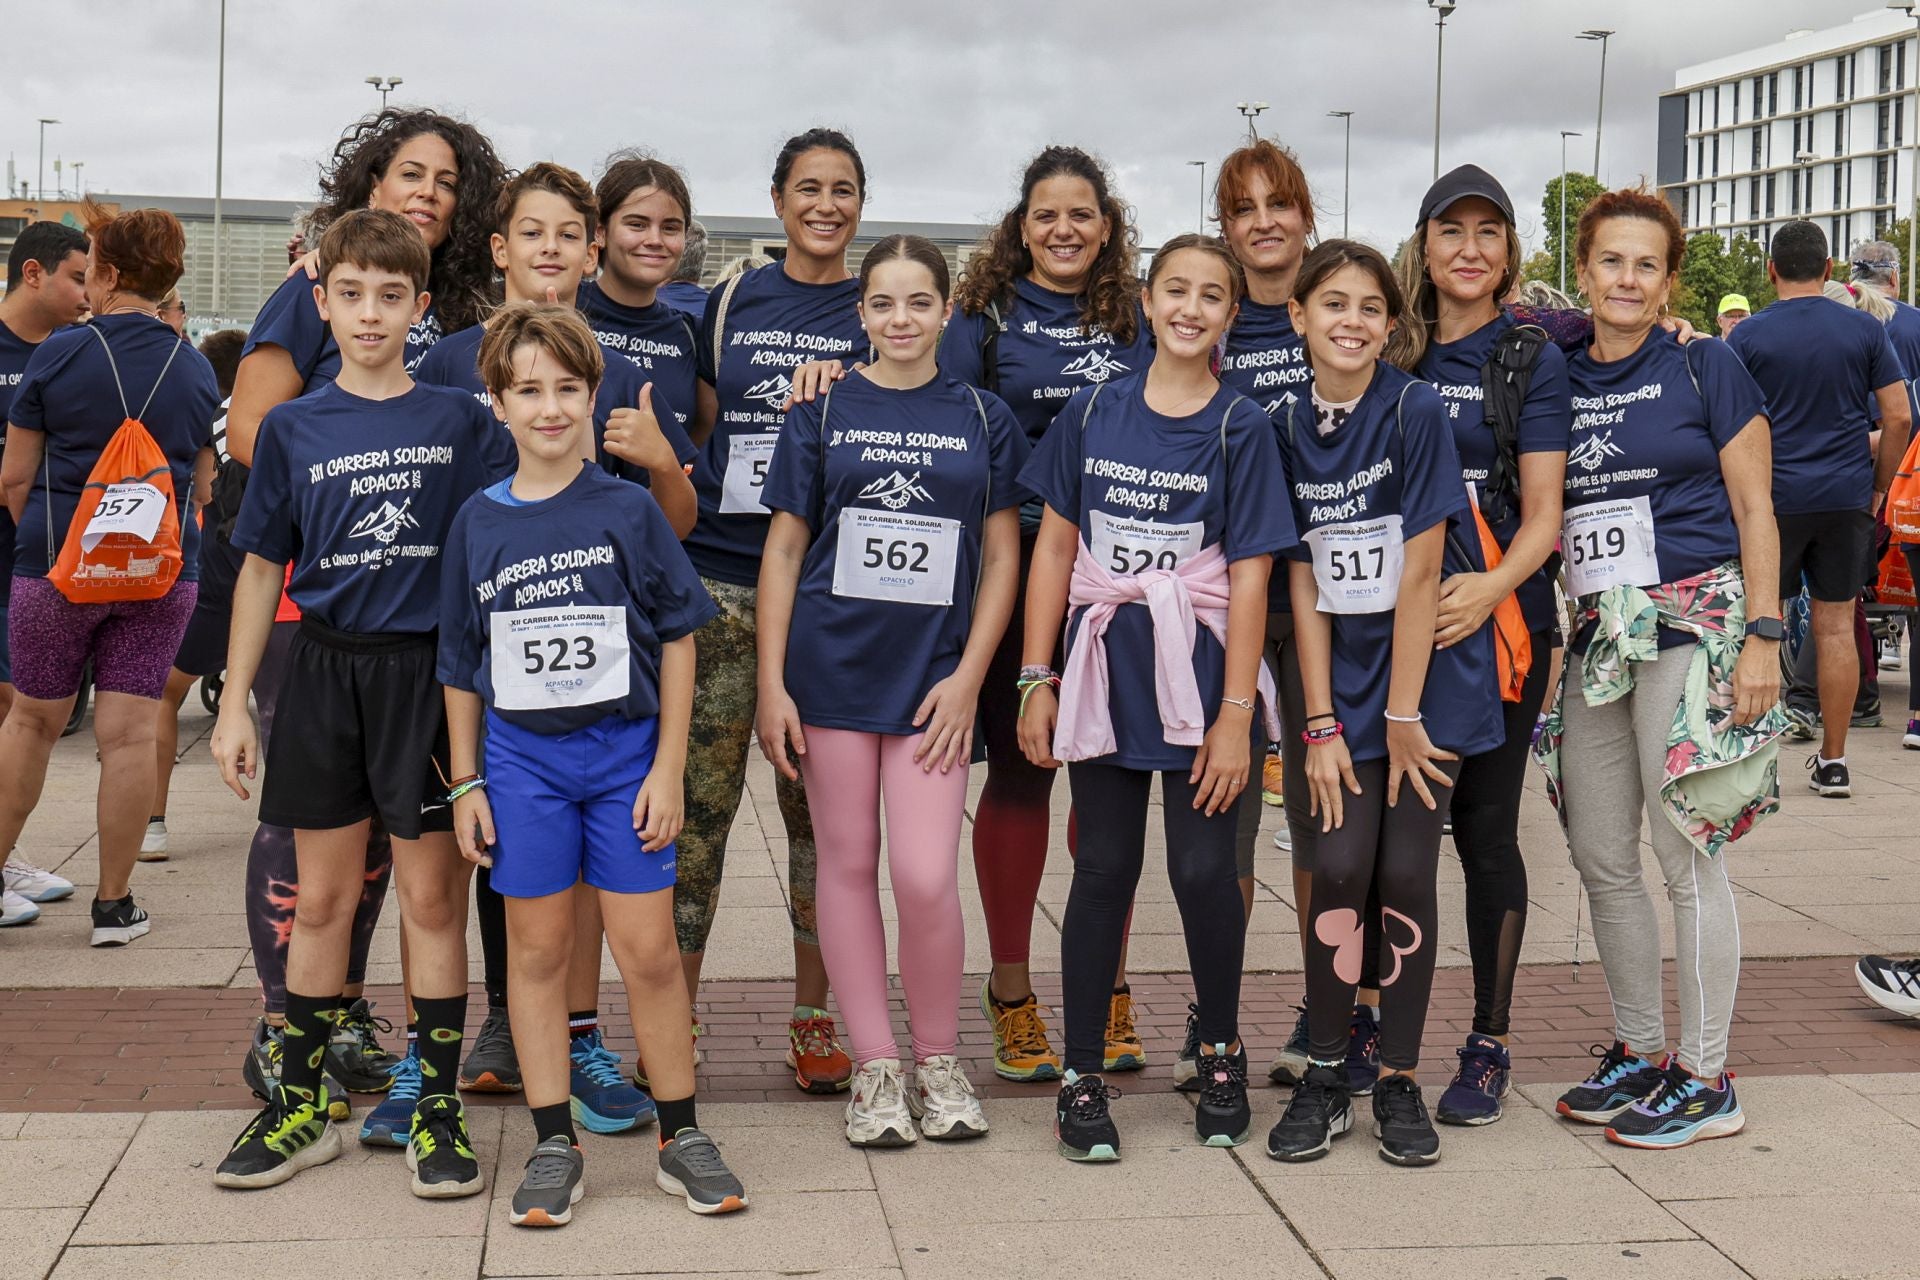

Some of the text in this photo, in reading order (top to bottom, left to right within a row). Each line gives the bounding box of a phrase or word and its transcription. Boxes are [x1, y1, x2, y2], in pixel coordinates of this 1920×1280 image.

[1022, 321, 1037, 334] XII
[628, 337, 682, 357] SOLIDARIA
[730, 331, 852, 352] XII CARRERA SOLIDARIA
[751, 350, 804, 367] ACPACYS
[1236, 348, 1289, 369] CARRERA
[1254, 366, 1309, 388] ACPACYS
[1033, 389, 1043, 399] EL
[1044, 386, 1070, 398] ÚNICO
[1571, 383, 1662, 411] RRERA SOLIDARIA
[724, 410, 785, 424] EL ÚNICO LÍMITE ES
[1571, 411, 1617, 432] ACPACYS
[829, 429, 968, 451] XII CARRERA SOLIDARIA
[309, 446, 452, 484] XII CARRERA SOLIDARIA
[861, 447, 920, 465] ACPACYS
[750, 460, 768, 487] 5
[1094, 459, 1147, 485] CARRERA
[1148, 470, 1208, 493] SOLIDARIA
[1572, 475, 1591, 488] LÍMITE
[1591, 475, 1599, 486] ES
[1600, 473, 1611, 485] NO
[1612, 468, 1658, 483] INTENTARLO
[350, 471, 410, 498] ACPACYS
[1295, 481, 1345, 500] CARRERA
[1105, 485, 1158, 510] ACPACYS
[1596, 505, 1633, 516] SOLIDARIA
[869, 515, 903, 525] CARRERA
[905, 519, 942, 529] SOLIDARIA
[1116, 524, 1149, 534] CARRERA
[1151, 528, 1190, 536] SOLIDARIA
[1356, 523, 1387, 535] SOLIDARIA
[863, 537, 929, 573] 562
[1573, 526, 1625, 566] 519
[320, 557, 332, 569] EL
[332, 553, 358, 566] ÚNICO
[360, 549, 382, 564] LÍMITE
[1110, 544, 1178, 576] 520
[1331, 546, 1384, 582] 517
[476, 545, 614, 604] XII CARRERA SOLIDARIA
[515, 576, 571, 609] ACPACYS
[1346, 587, 1372, 595] ACPACYS
[523, 615, 559, 625] CARRERA
[523, 636, 597, 675] 523
[545, 680, 573, 688] ACPACYS
